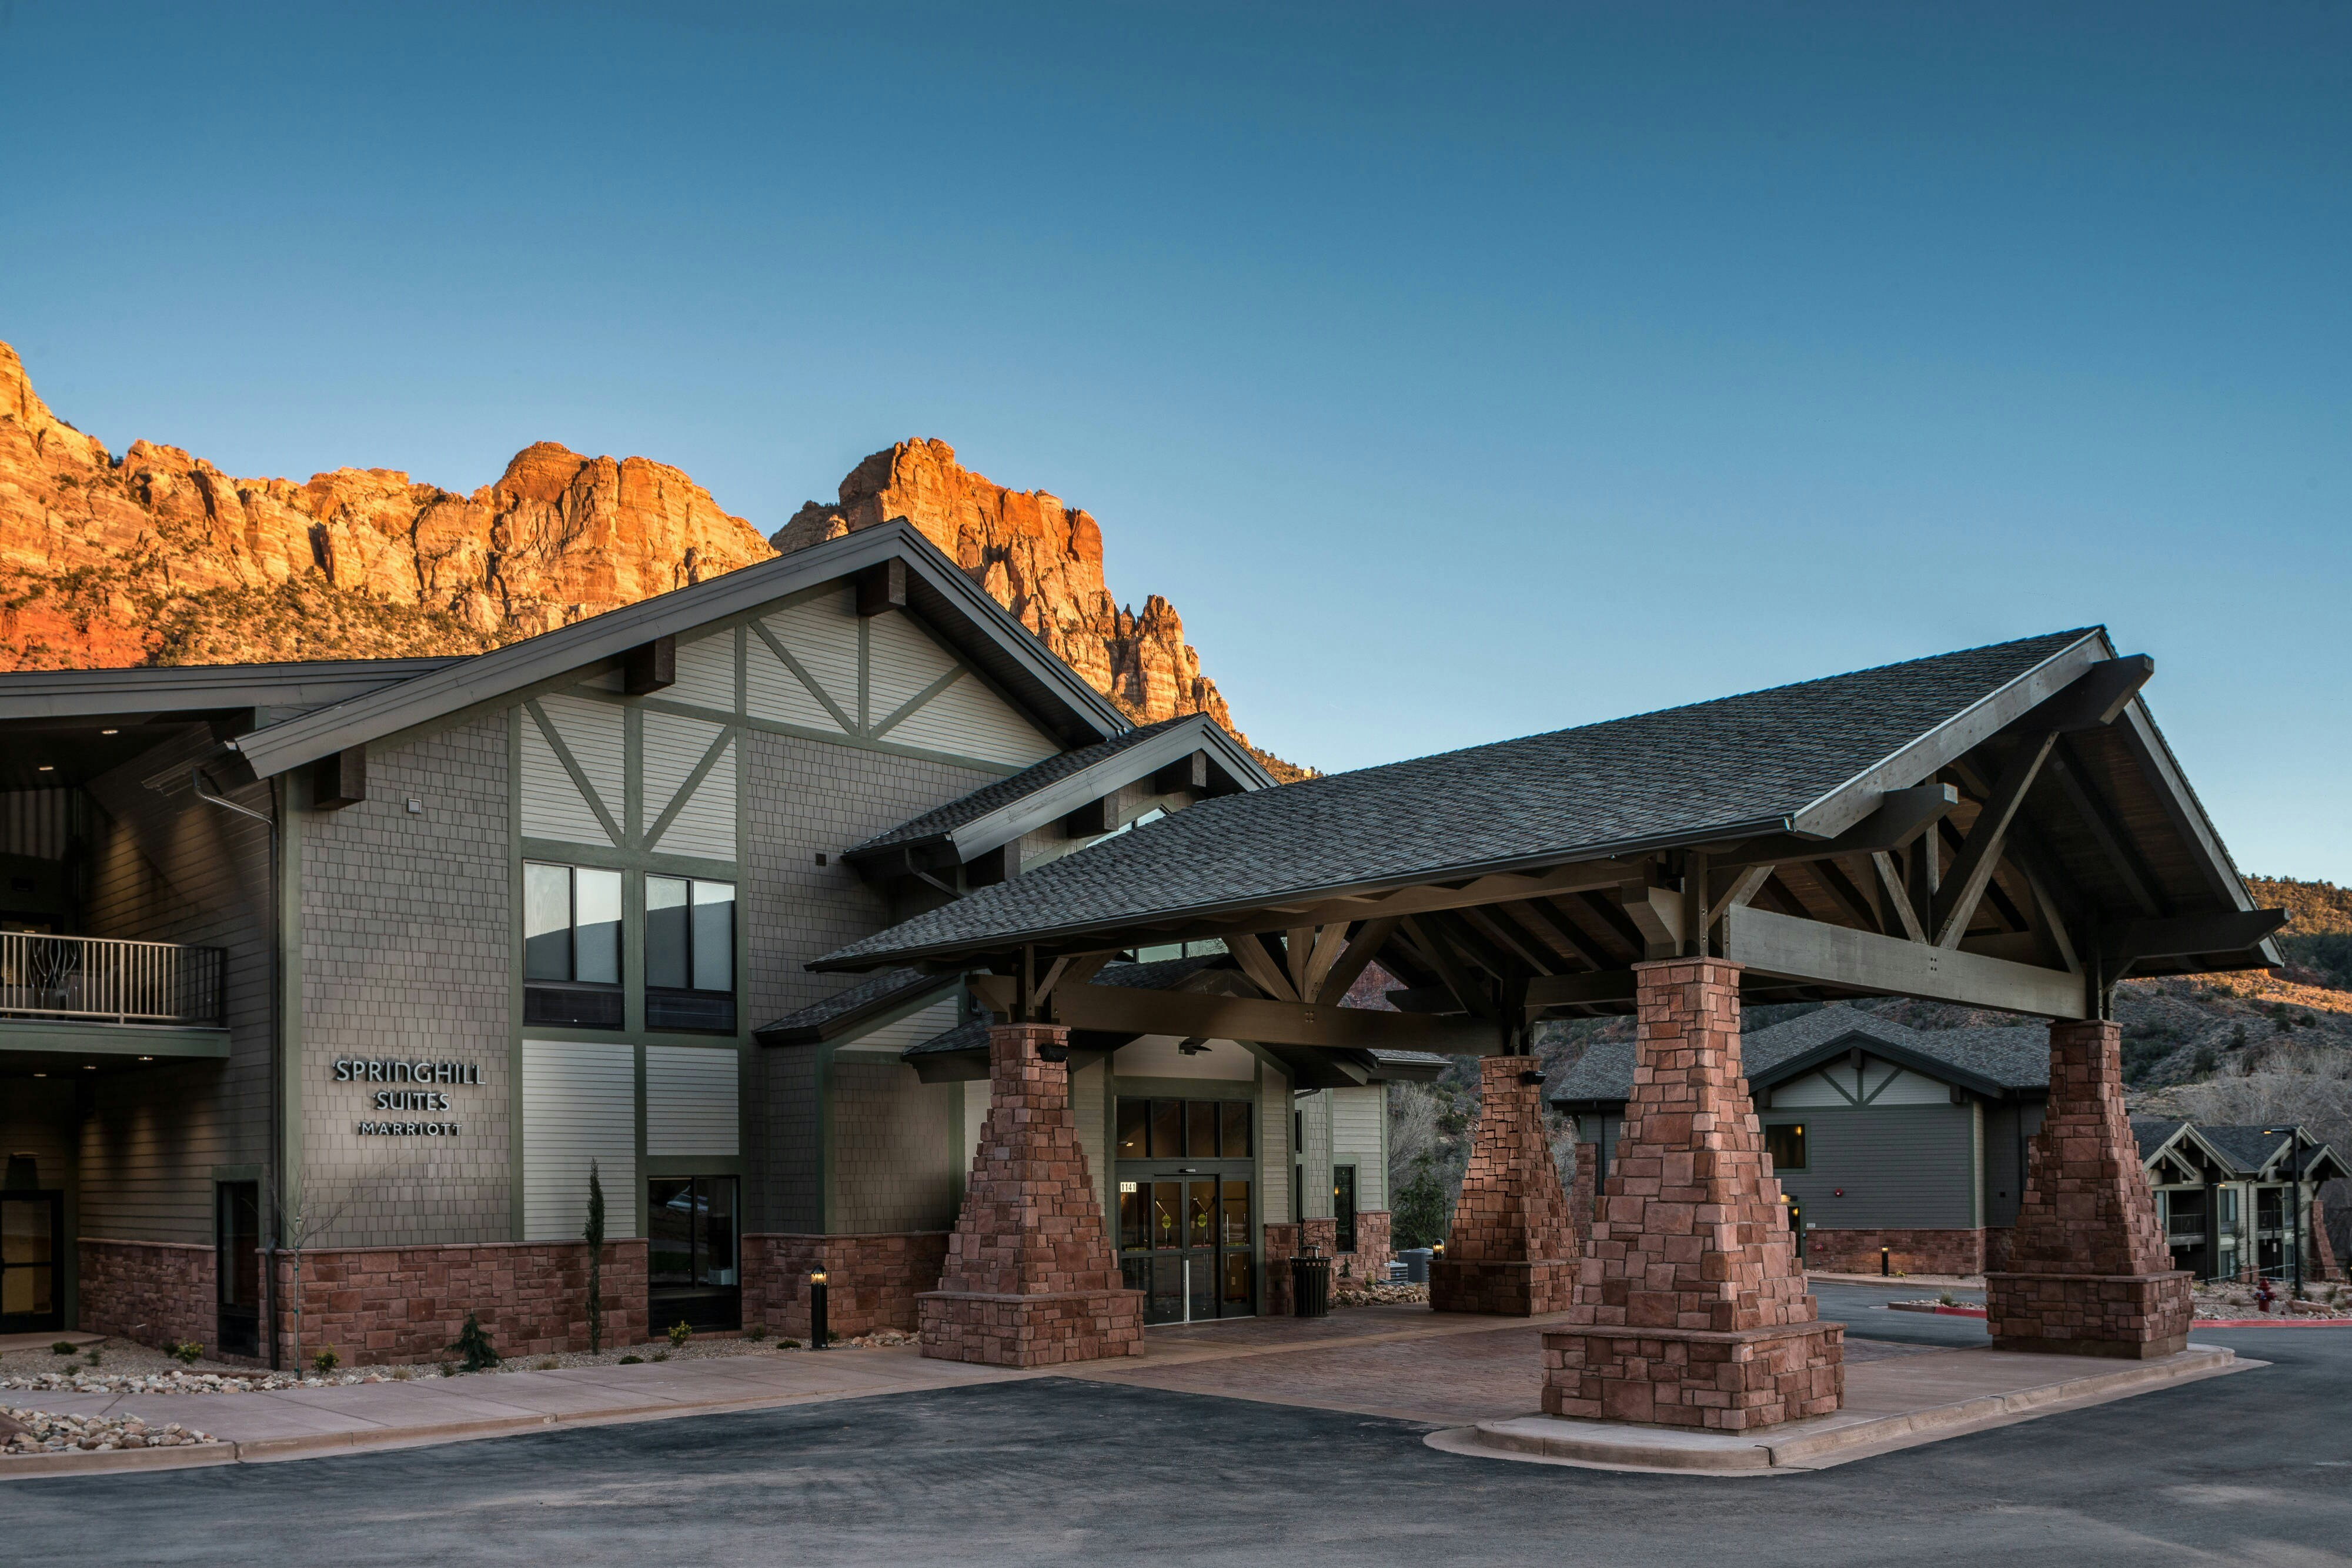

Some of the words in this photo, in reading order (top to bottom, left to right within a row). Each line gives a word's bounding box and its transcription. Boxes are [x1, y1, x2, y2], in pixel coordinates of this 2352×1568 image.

[336, 1060, 486, 1085] SPRINGHILL
[376, 1092, 450, 1111] SUITES
[361, 1123, 463, 1136] MARRIOTT
[1121, 1183, 1135, 1192] 1141
